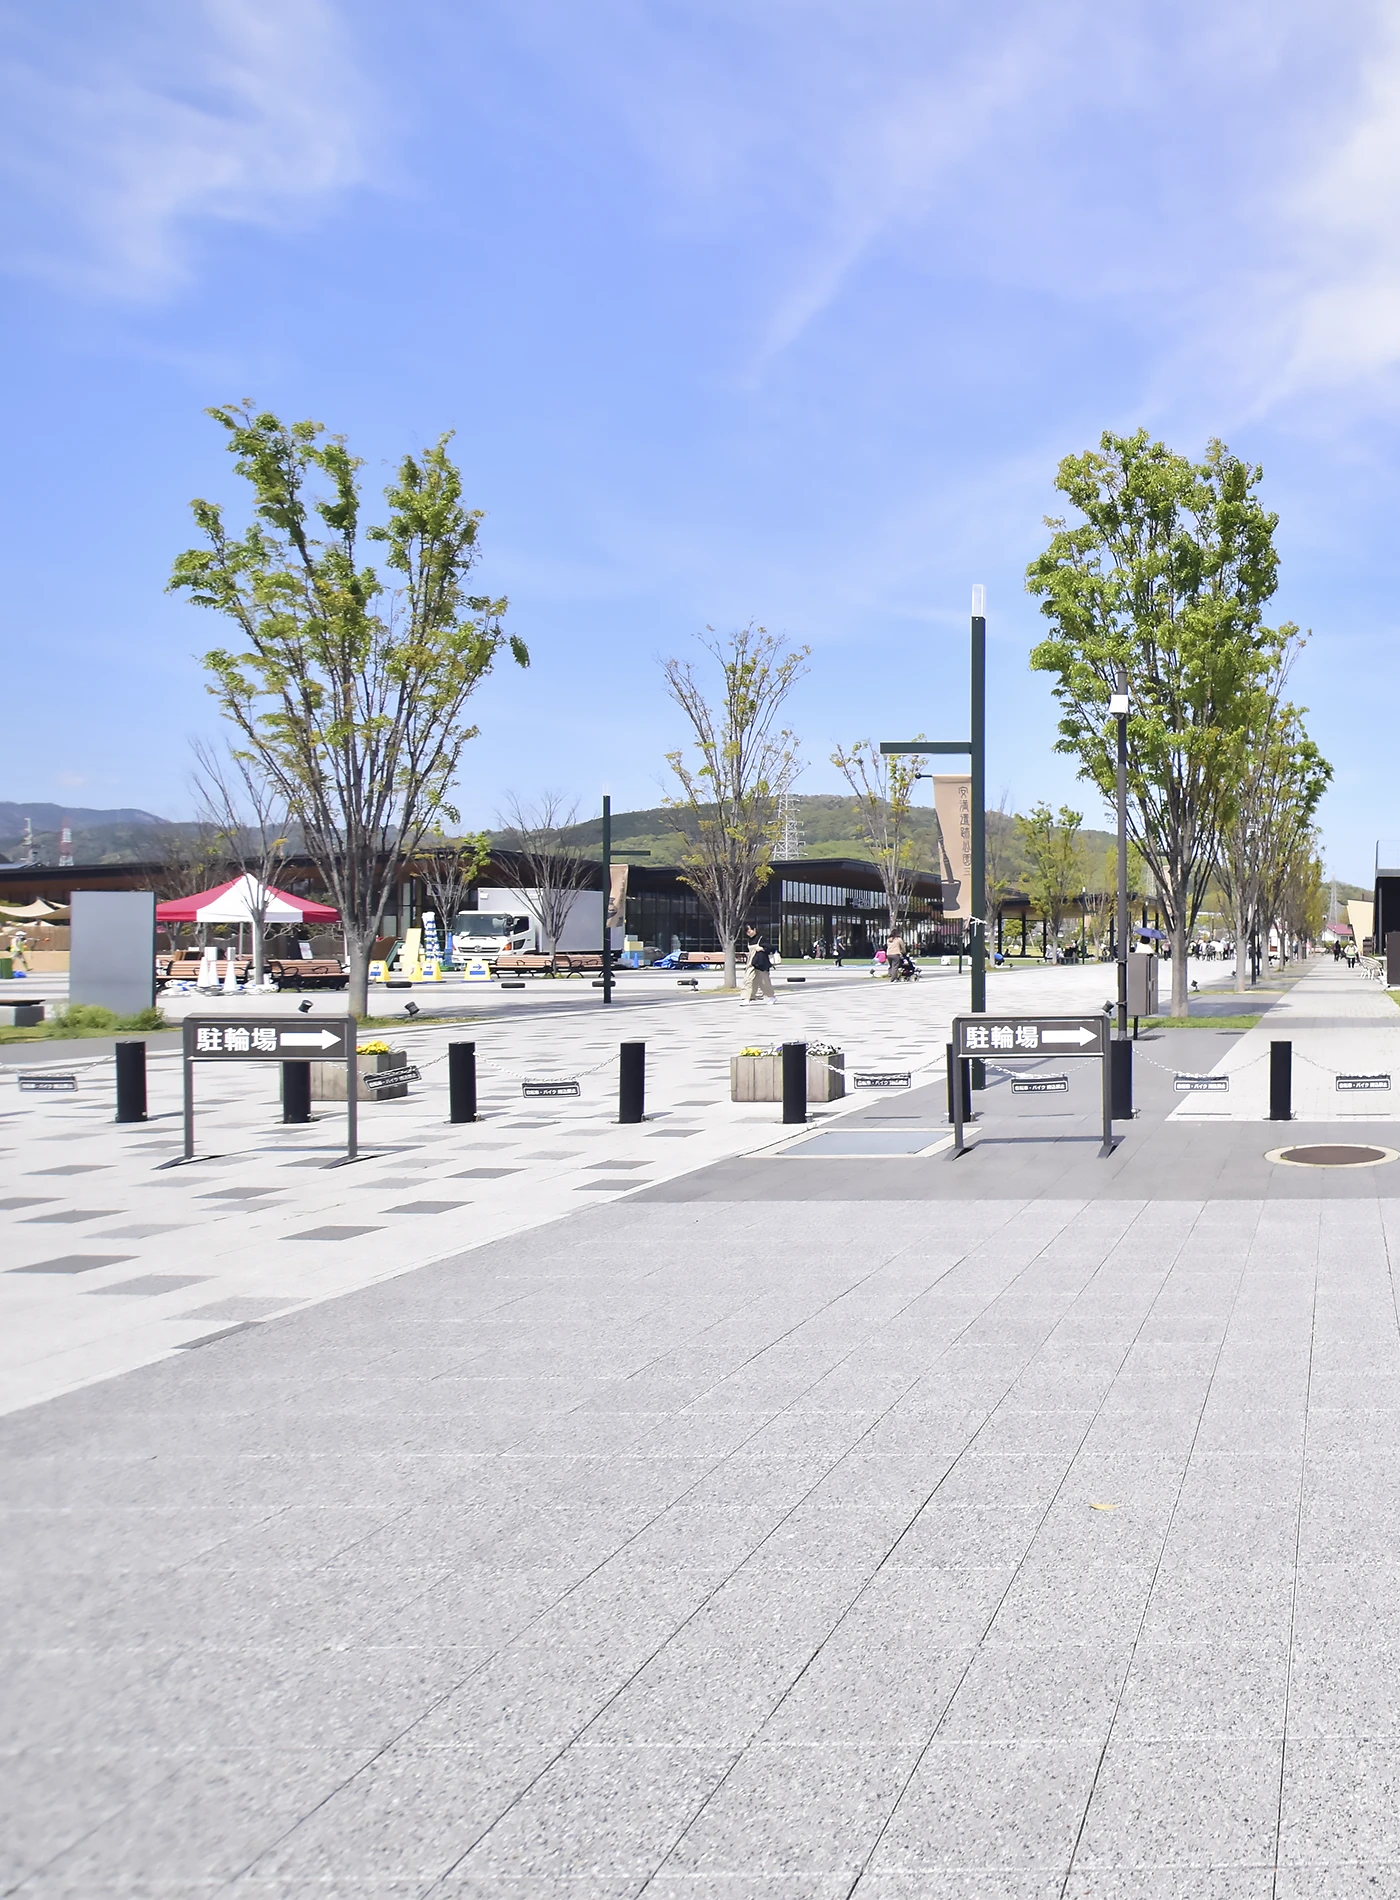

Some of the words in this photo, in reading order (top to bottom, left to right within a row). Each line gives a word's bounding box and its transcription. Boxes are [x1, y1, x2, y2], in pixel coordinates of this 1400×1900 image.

[196, 1027, 278, 1052] 駐輪場
[966, 1025, 1039, 1049] 駐輪場
